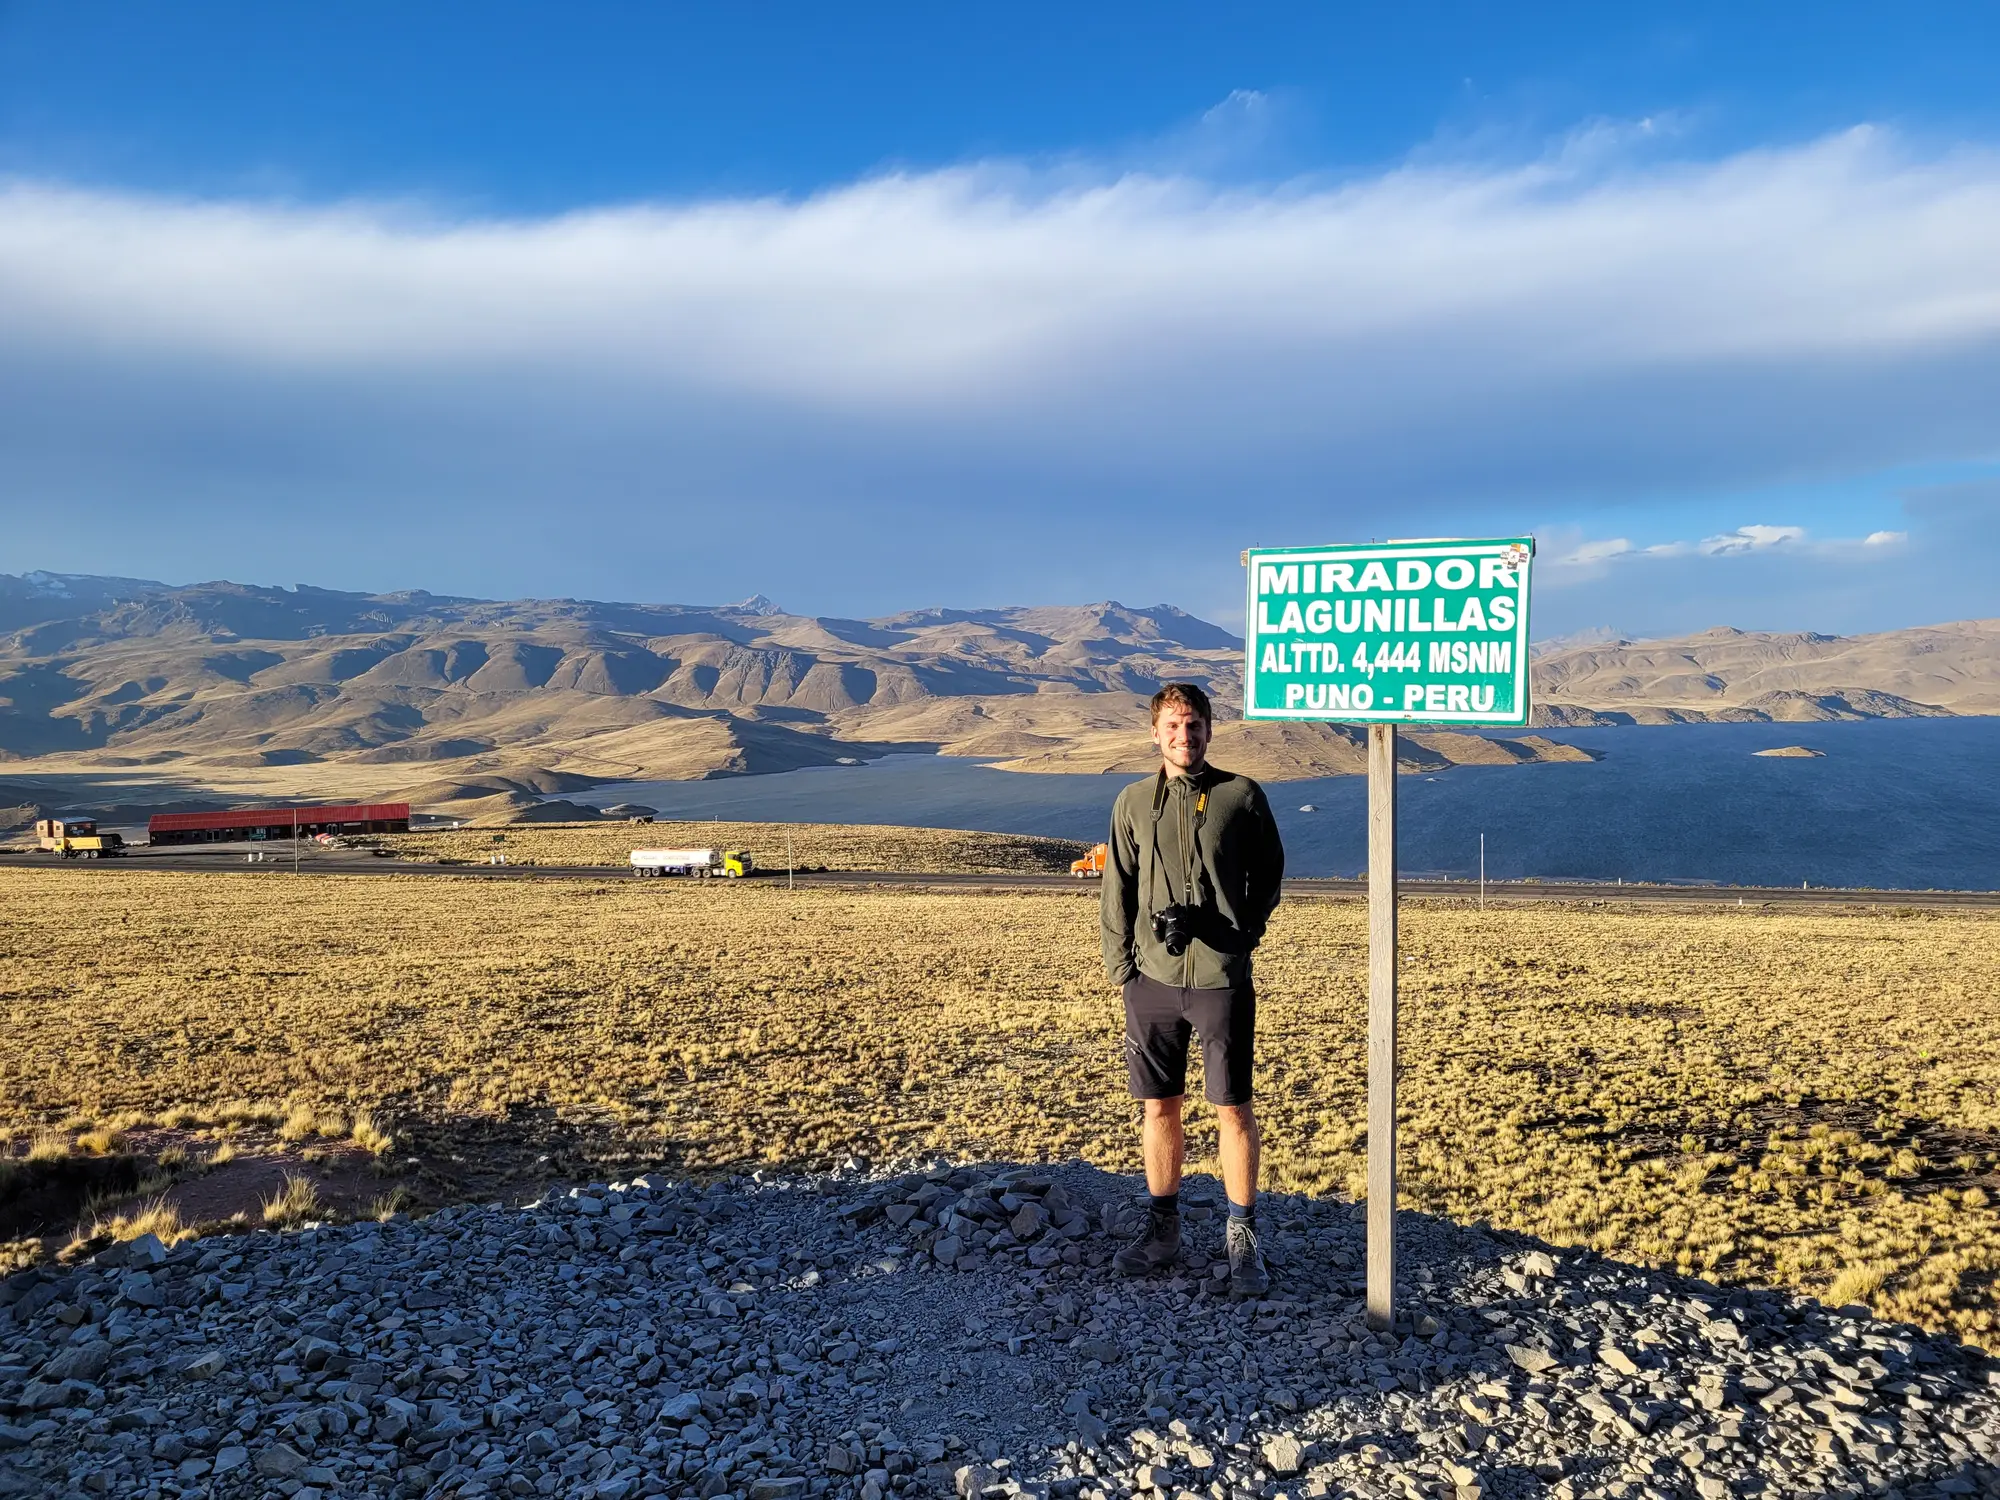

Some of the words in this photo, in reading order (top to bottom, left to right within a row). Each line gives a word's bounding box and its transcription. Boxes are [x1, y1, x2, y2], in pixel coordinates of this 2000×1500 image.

[1259, 558, 1519, 595] MIRADOR
[1258, 596, 1516, 634] LAGUNILLAS
[1260, 642, 1345, 674] ALTTD.
[1352, 641, 1421, 680] 4,444
[1428, 641, 1512, 674] MSNM
[1286, 683, 1374, 711] PUNO
[1383, 695, 1394, 705] -
[1404, 683, 1495, 711] PERU
